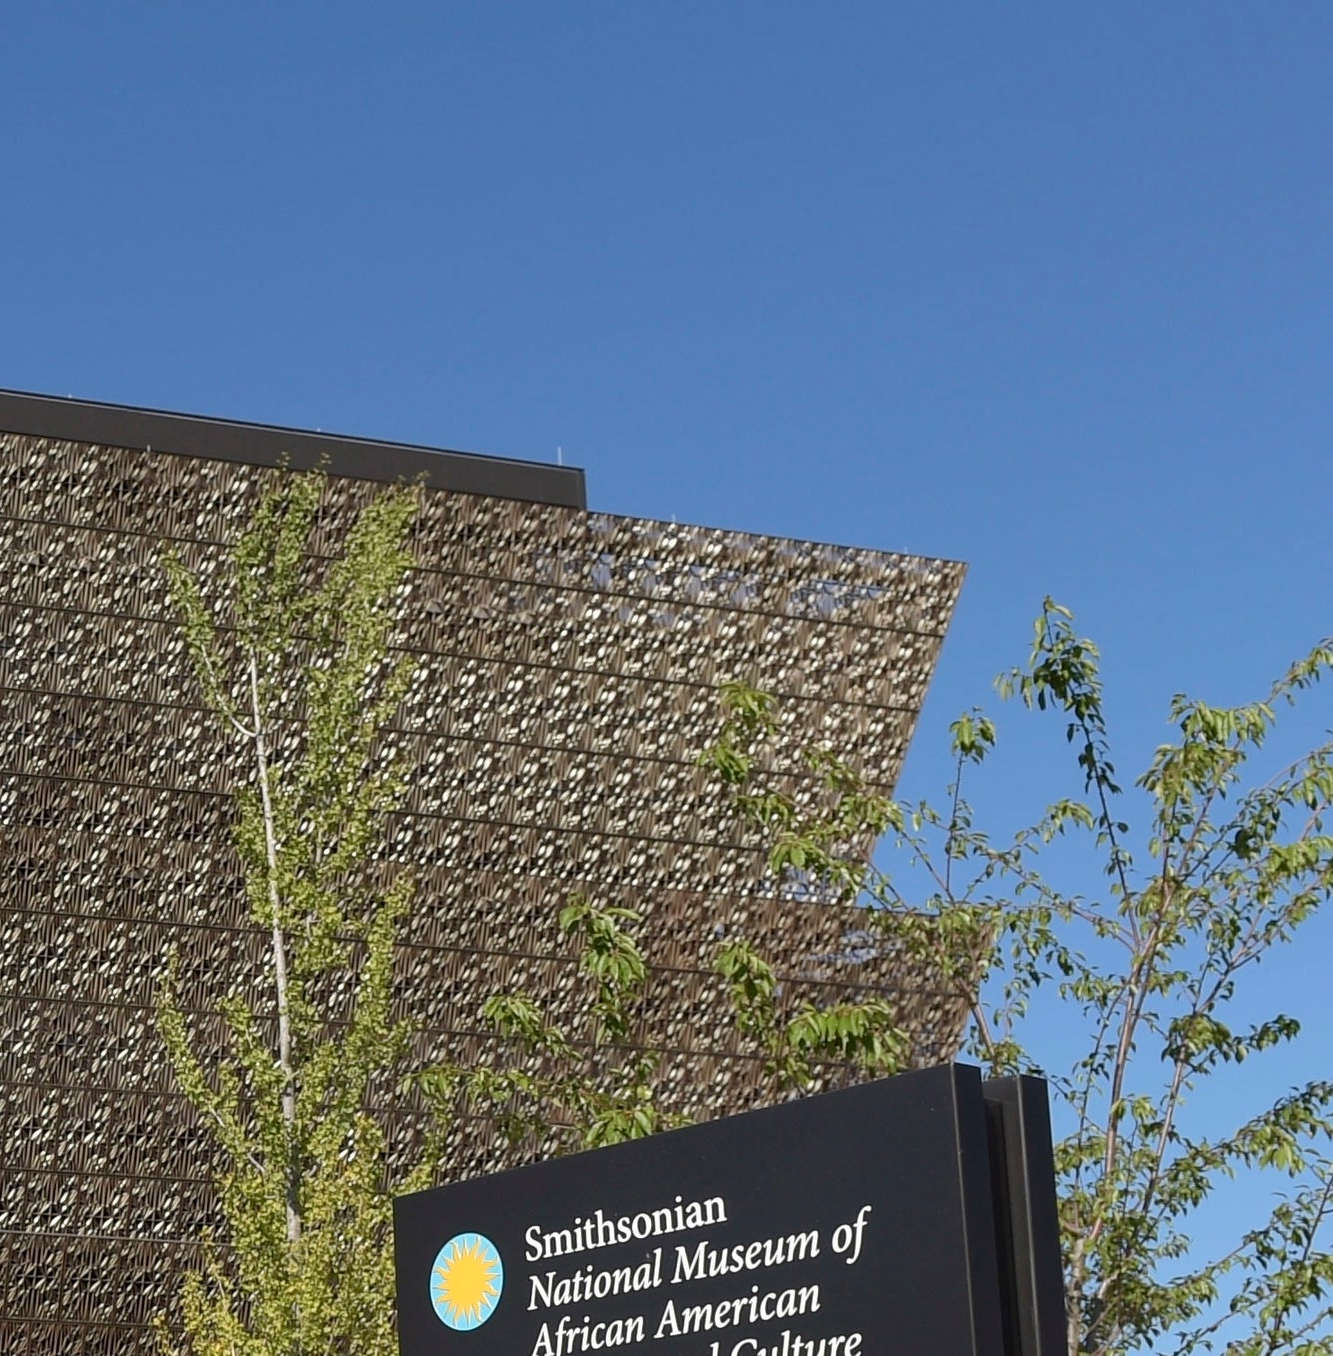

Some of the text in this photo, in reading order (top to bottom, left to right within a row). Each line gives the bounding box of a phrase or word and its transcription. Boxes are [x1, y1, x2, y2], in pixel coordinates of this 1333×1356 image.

[525, 1196, 726, 1262] Smithsonian
[527, 1205, 872, 1311] National Museum of
[654, 1284, 821, 1341] American
